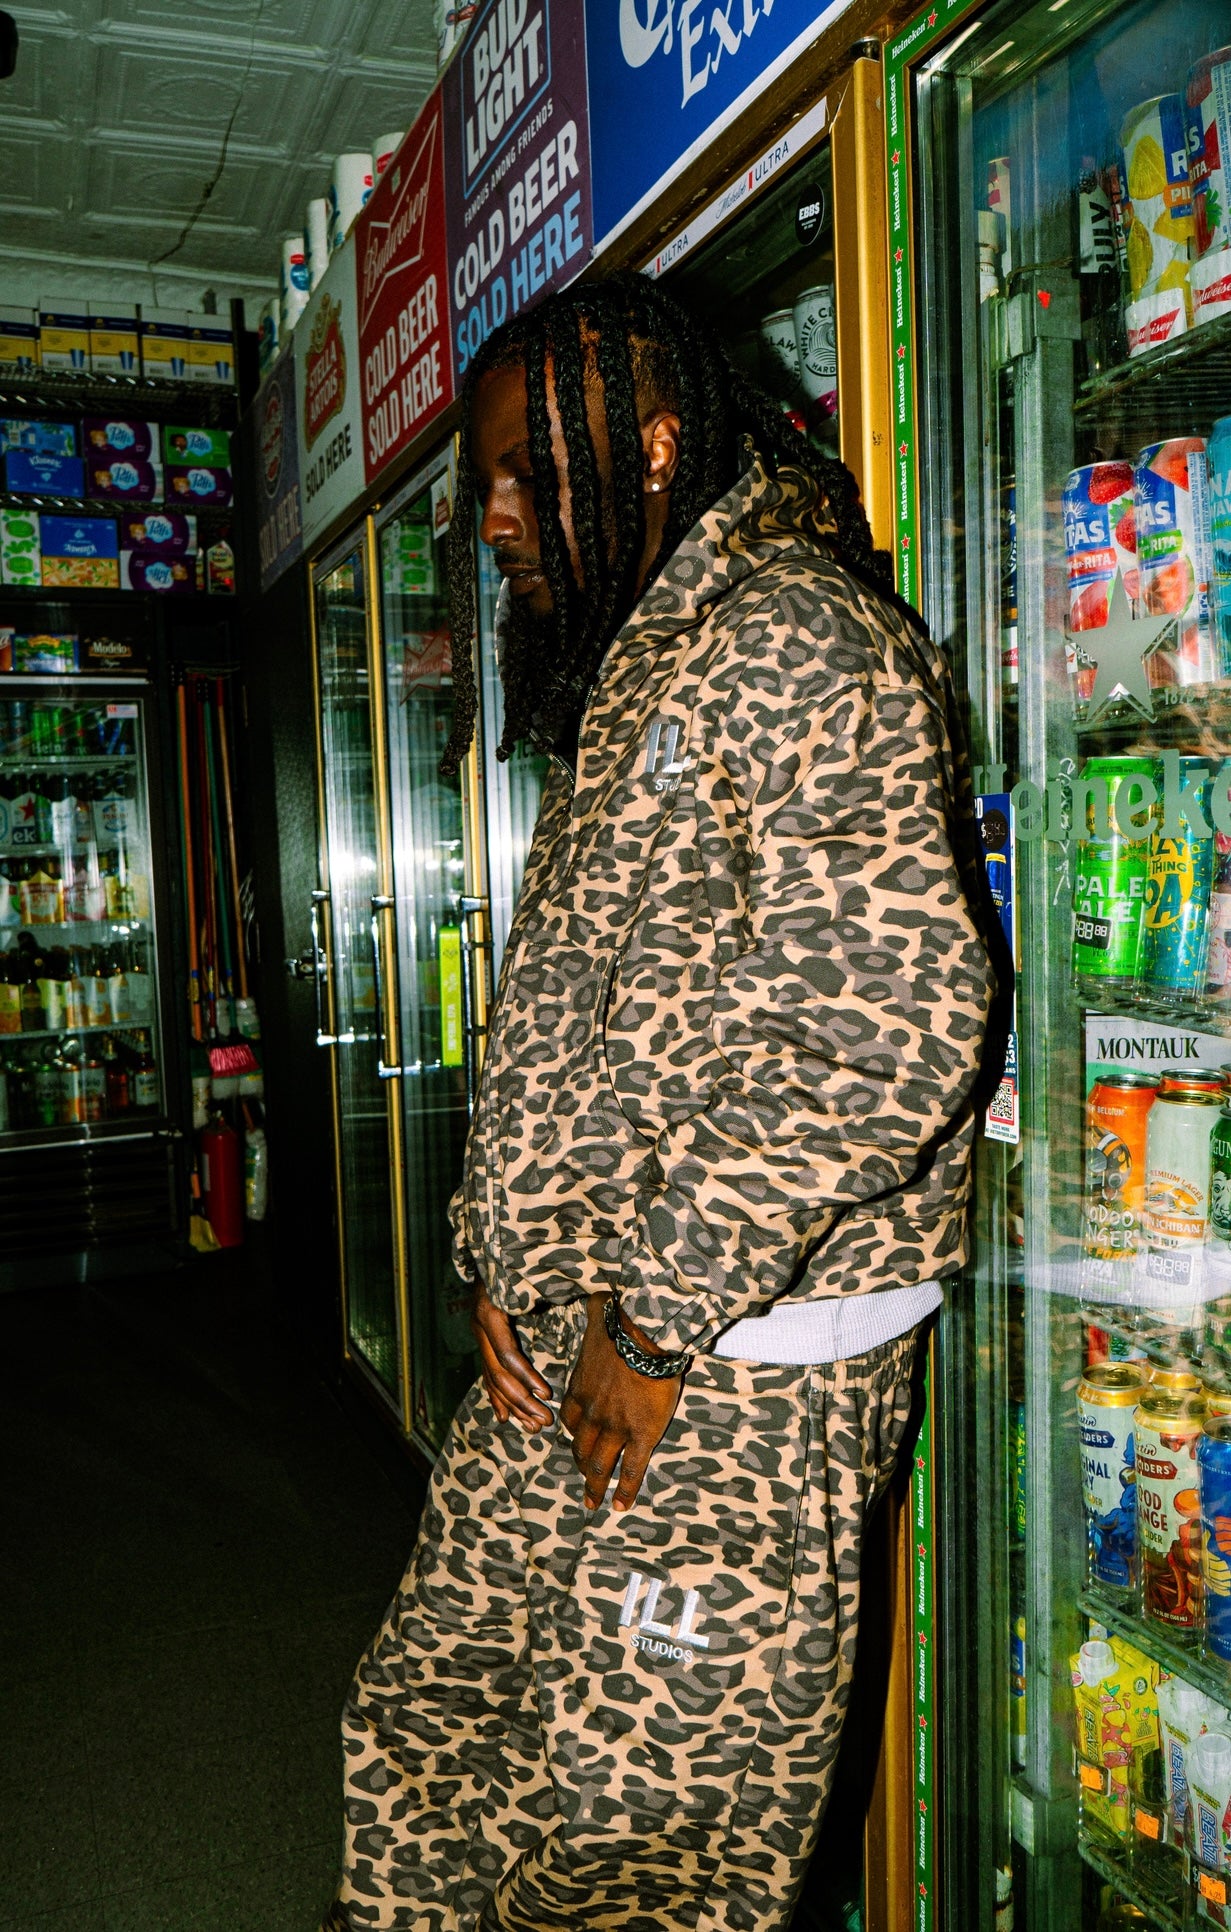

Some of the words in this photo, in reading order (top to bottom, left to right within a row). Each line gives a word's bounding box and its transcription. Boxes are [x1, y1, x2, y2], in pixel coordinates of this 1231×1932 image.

[473, 0, 528, 104] BUD
[891, 18, 926, 60] Heineken
[466, 10, 543, 177] LIGHT
[889, 73, 898, 137] Heineken
[464, 182, 490, 229] FAMOUS
[491, 146, 516, 191] AMONG
[518, 98, 554, 154] FRIENDS
[754, 140, 790, 182] ULTRA
[454, 208, 505, 311] COLD
[508, 119, 580, 246] BEER
[798, 202, 821, 221] EBBS
[892, 168, 900, 231] Heineken
[363, 182, 429, 298] Budweiser
[660, 233, 690, 268] ULTRA
[456, 276, 508, 374] SOLD
[510, 189, 584, 314] HERE
[894, 267, 903, 329] Heineken
[365, 326, 397, 405] COLD
[398, 273, 440, 365] BEER
[800, 314, 818, 360] WHITE
[309, 340, 337, 397] STELLA
[310, 368, 339, 421] ARTOIS
[368, 390, 400, 466] SOLD
[401, 340, 444, 430] HERE
[306, 453, 325, 503] SOLD
[326, 422, 353, 480] HERE
[900, 460, 908, 521] Heineken
[93, 642, 127, 654] Modelo
[1075, 875, 1145, 898] PALE
[1151, 861, 1187, 875] THING
[1080, 900, 1136, 923] ALE
[1145, 873, 1184, 924] PA
[1096, 1037, 1200, 1060] MONTAUK
[1181, 1179, 1204, 1202] LAGER
[1157, 1219, 1200, 1234] ICHIBAN
[618, 1571, 710, 1648] ILL
[917, 1559, 925, 1616] Heineken
[630, 1633, 694, 1663] STUDIOS
[918, 1646, 926, 1703] Heineken
[918, 1728, 926, 1785] Heineken
[918, 1812, 926, 1870] Heineken
